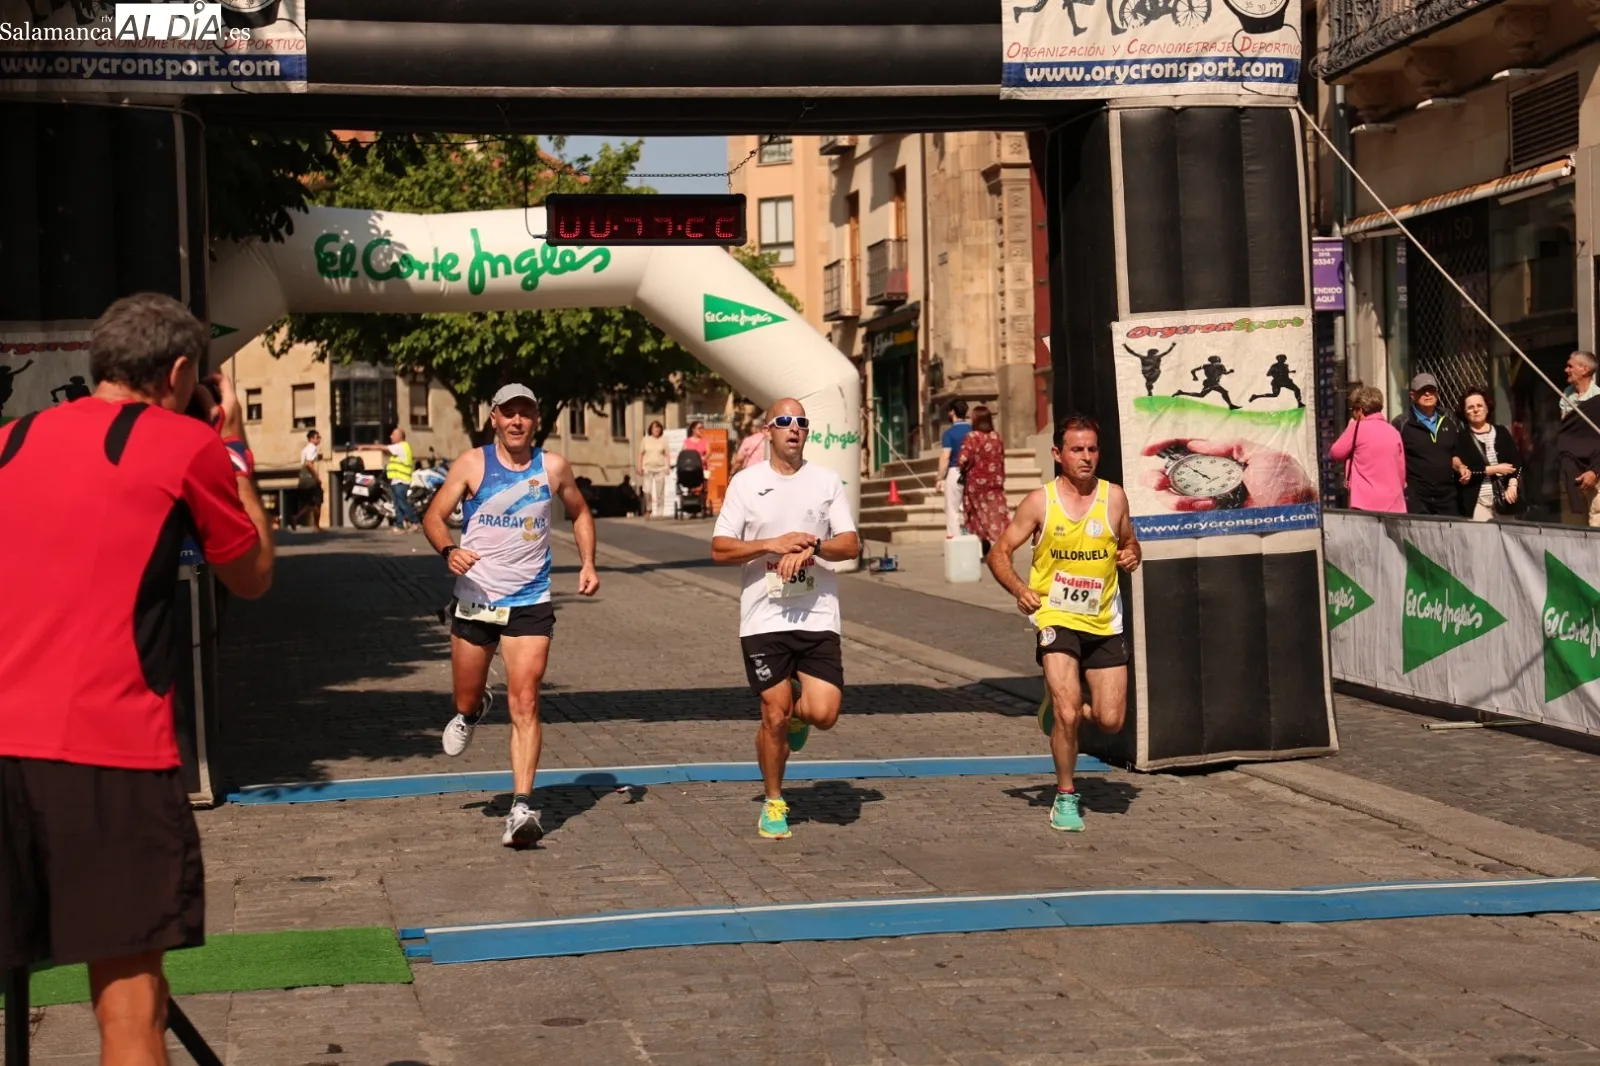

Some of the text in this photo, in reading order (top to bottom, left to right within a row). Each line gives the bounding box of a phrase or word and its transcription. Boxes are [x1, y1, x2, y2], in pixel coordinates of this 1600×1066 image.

[1007, 36, 1301, 58] ORGANIZACIÓN Y CRONOMETRAJE DEPORTIVO
[1024, 58, 1284, 85] www.orycronsport.com
[314, 233, 358, 279] El
[362, 237, 462, 282] Corte
[1313, 287, 1342, 295] ENDIDO
[1139, 512, 1317, 534] www.orycronsport.com
[1050, 548, 1109, 561] VILLORUELA
[1054, 572, 1102, 590] bedunia
[1063, 587, 1089, 603] 169
[1328, 586, 1355, 616] nglés
[1406, 588, 1417, 617] El
[1417, 592, 1443, 622] Corte
[1544, 606, 1559, 638] El
[1558, 610, 1590, 645] Corte
